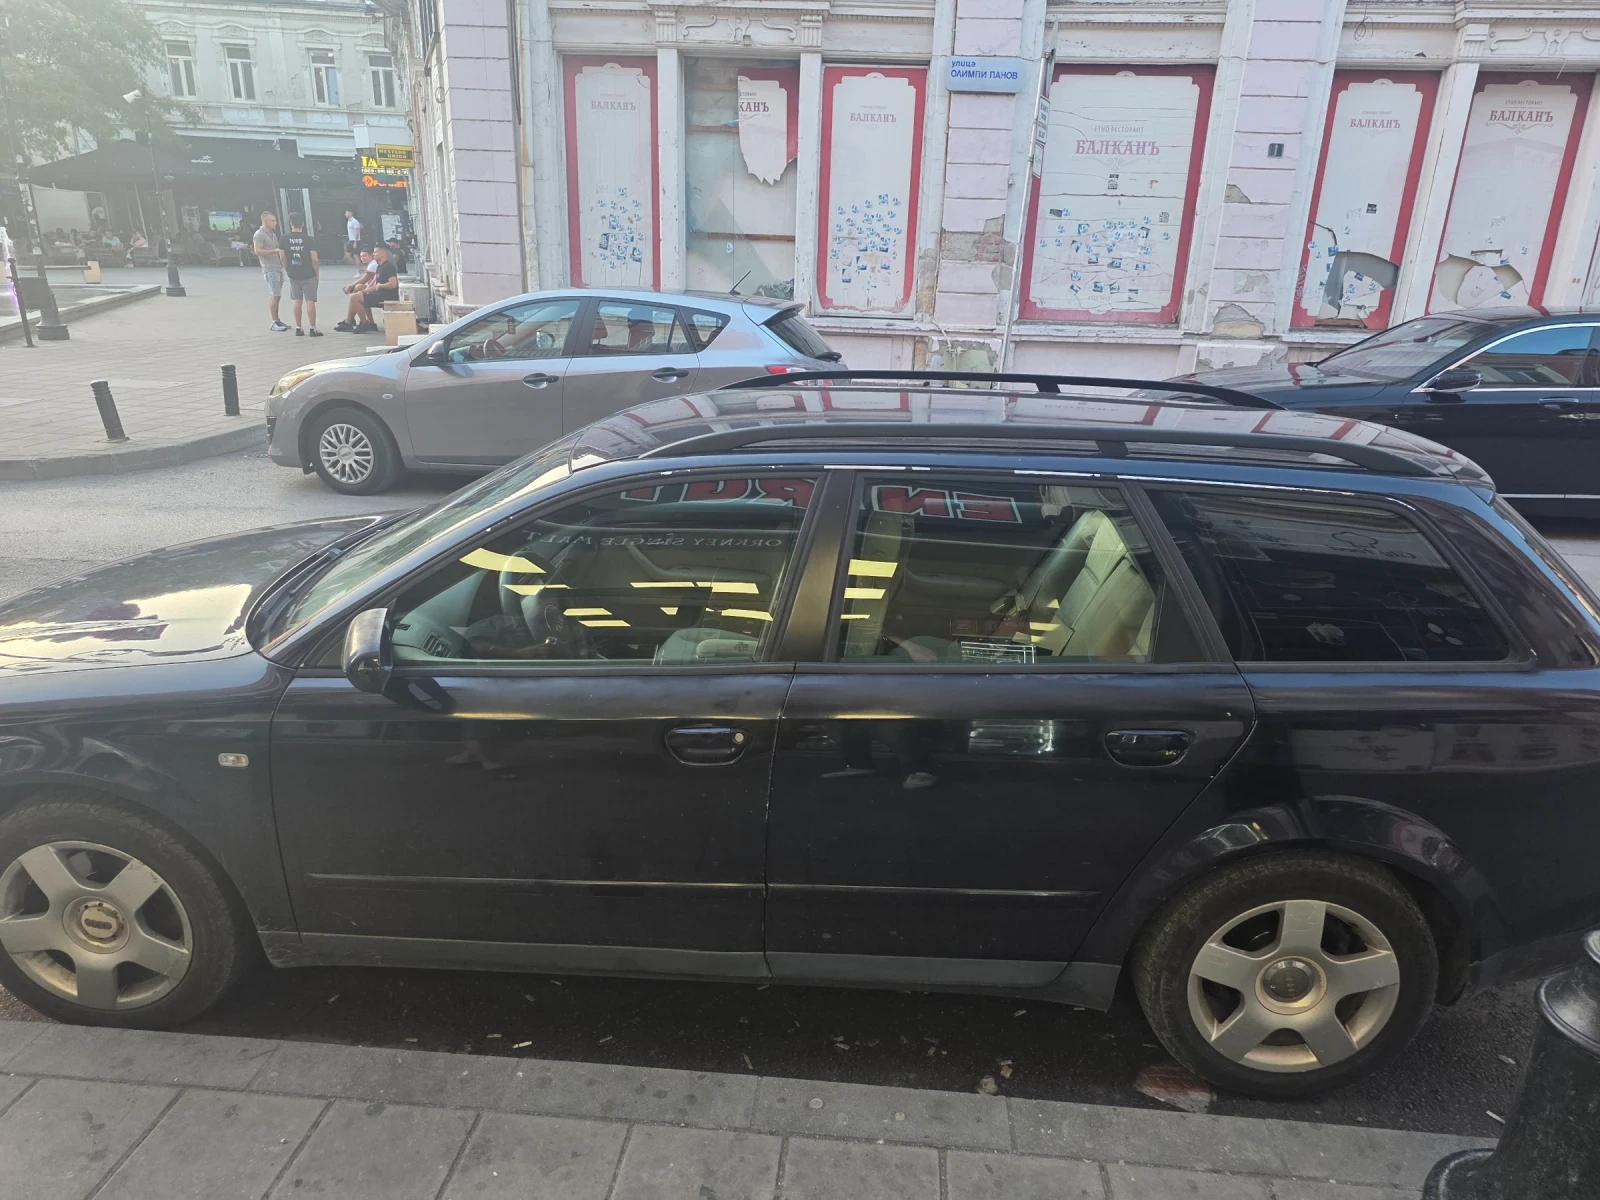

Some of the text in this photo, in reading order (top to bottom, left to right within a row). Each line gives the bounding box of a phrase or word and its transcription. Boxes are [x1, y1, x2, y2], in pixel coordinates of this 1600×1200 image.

[951, 60, 976, 68] улица
[950, 69, 1018, 80] ОЛИМПИ ПАНОВ
[590, 100, 636, 111] БАЛКАНЪ
[849, 112, 897, 123] БАЛКАНЪ
[1489, 109, 1554, 123] БАЛКАНЪ
[1349, 118, 1401, 129] БАЛКАНЪ
[1074, 139, 1160, 156] БАЛКАНЪ
